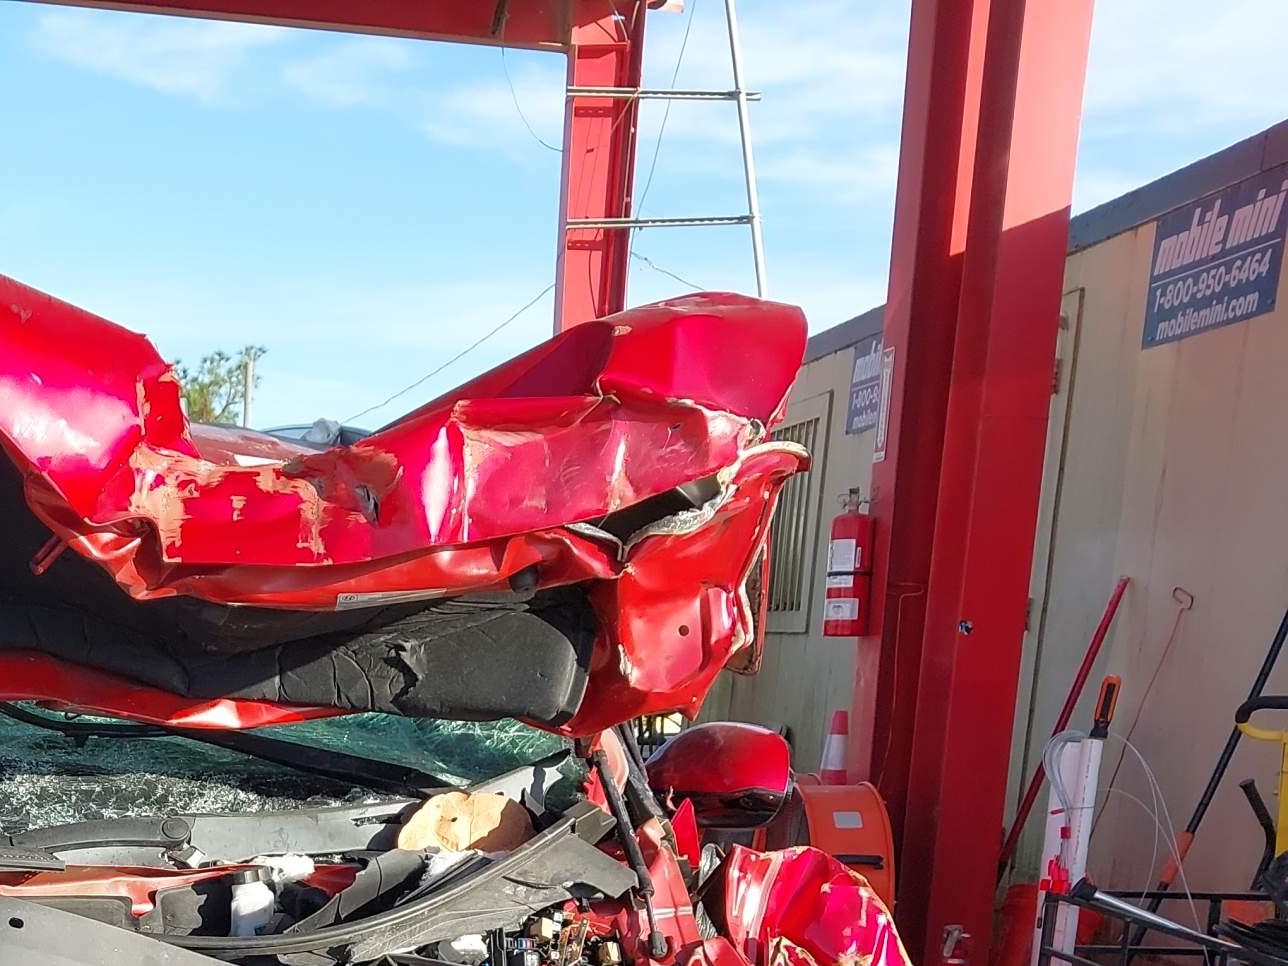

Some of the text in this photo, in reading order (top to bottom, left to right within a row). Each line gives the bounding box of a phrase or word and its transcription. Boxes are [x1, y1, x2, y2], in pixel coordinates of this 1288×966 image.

[1154, 179, 1288, 276] mobile mini
[1154, 249, 1272, 313] 1-800-950-6464
[1155, 292, 1259, 341] mobilemini.com
